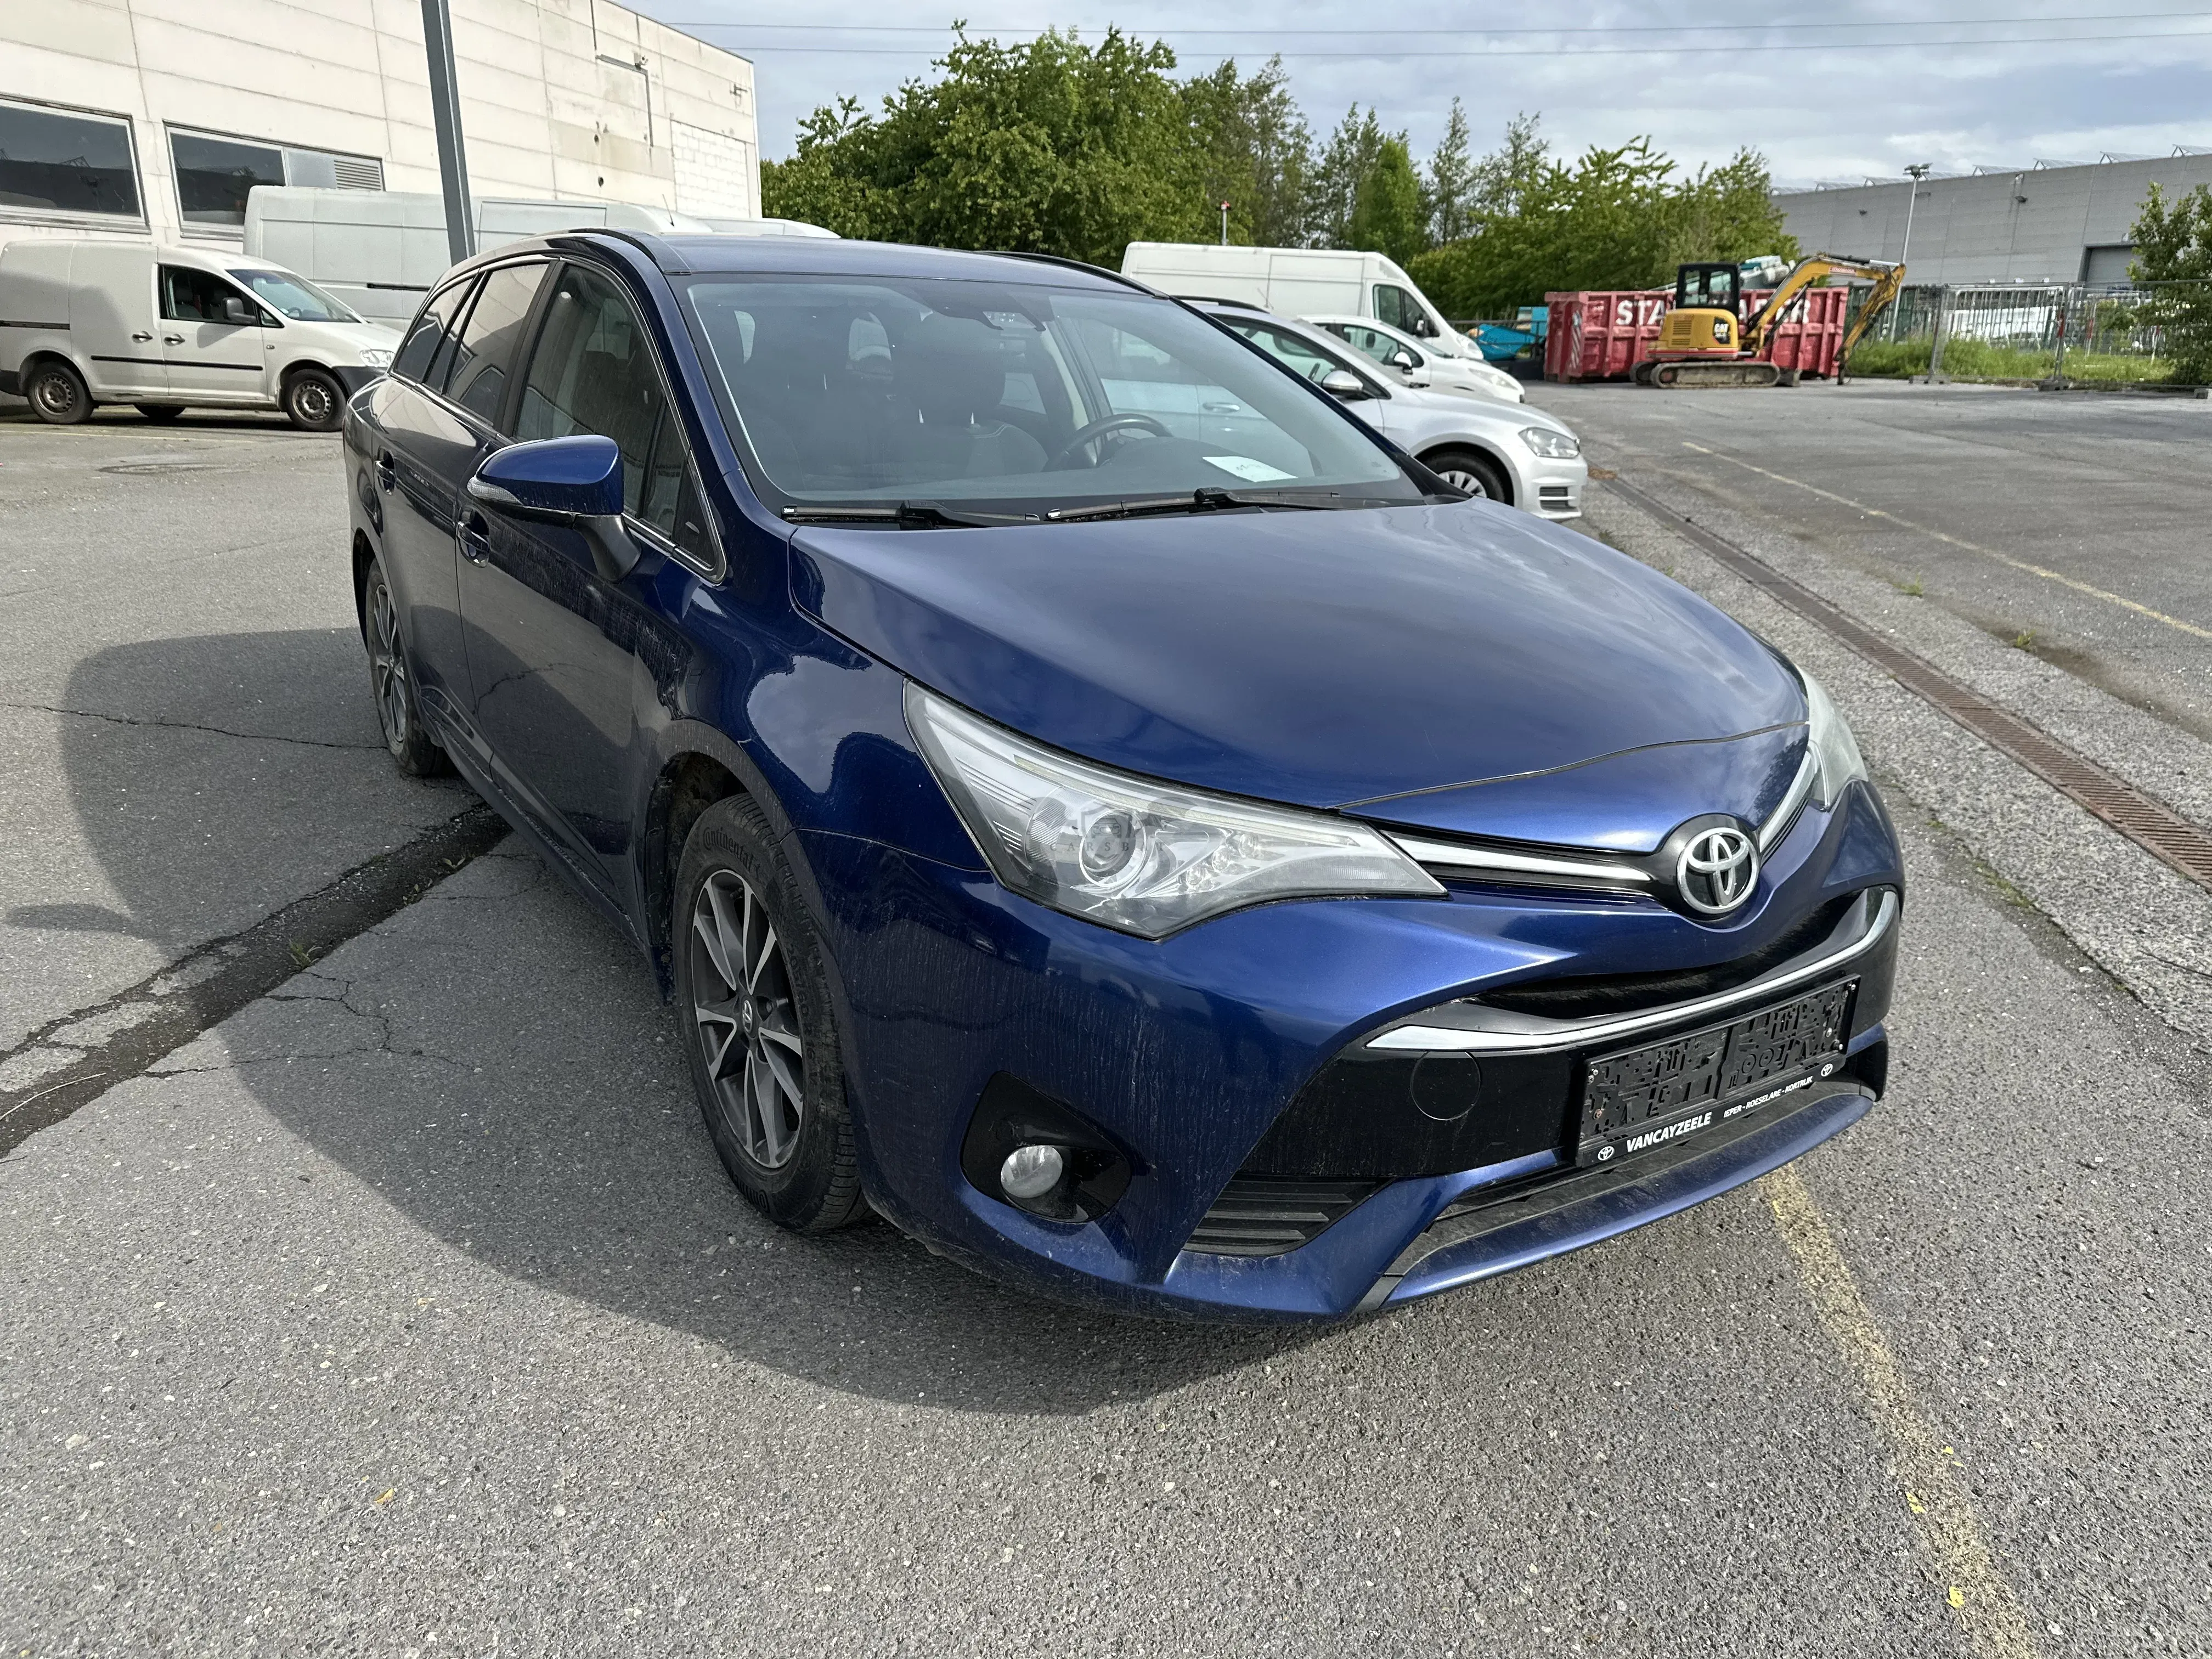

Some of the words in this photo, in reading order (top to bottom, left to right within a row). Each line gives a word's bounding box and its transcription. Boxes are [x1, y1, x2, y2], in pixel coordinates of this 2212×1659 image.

[703, 826, 754, 873] Continental
[1723, 1104, 1742, 1118] IEPER
[1746, 1089, 1782, 1109] ROESELARE
[1785, 1075, 1813, 1093] KORTRIJK
[1627, 1111, 1712, 1152] VANCAYZEELE
